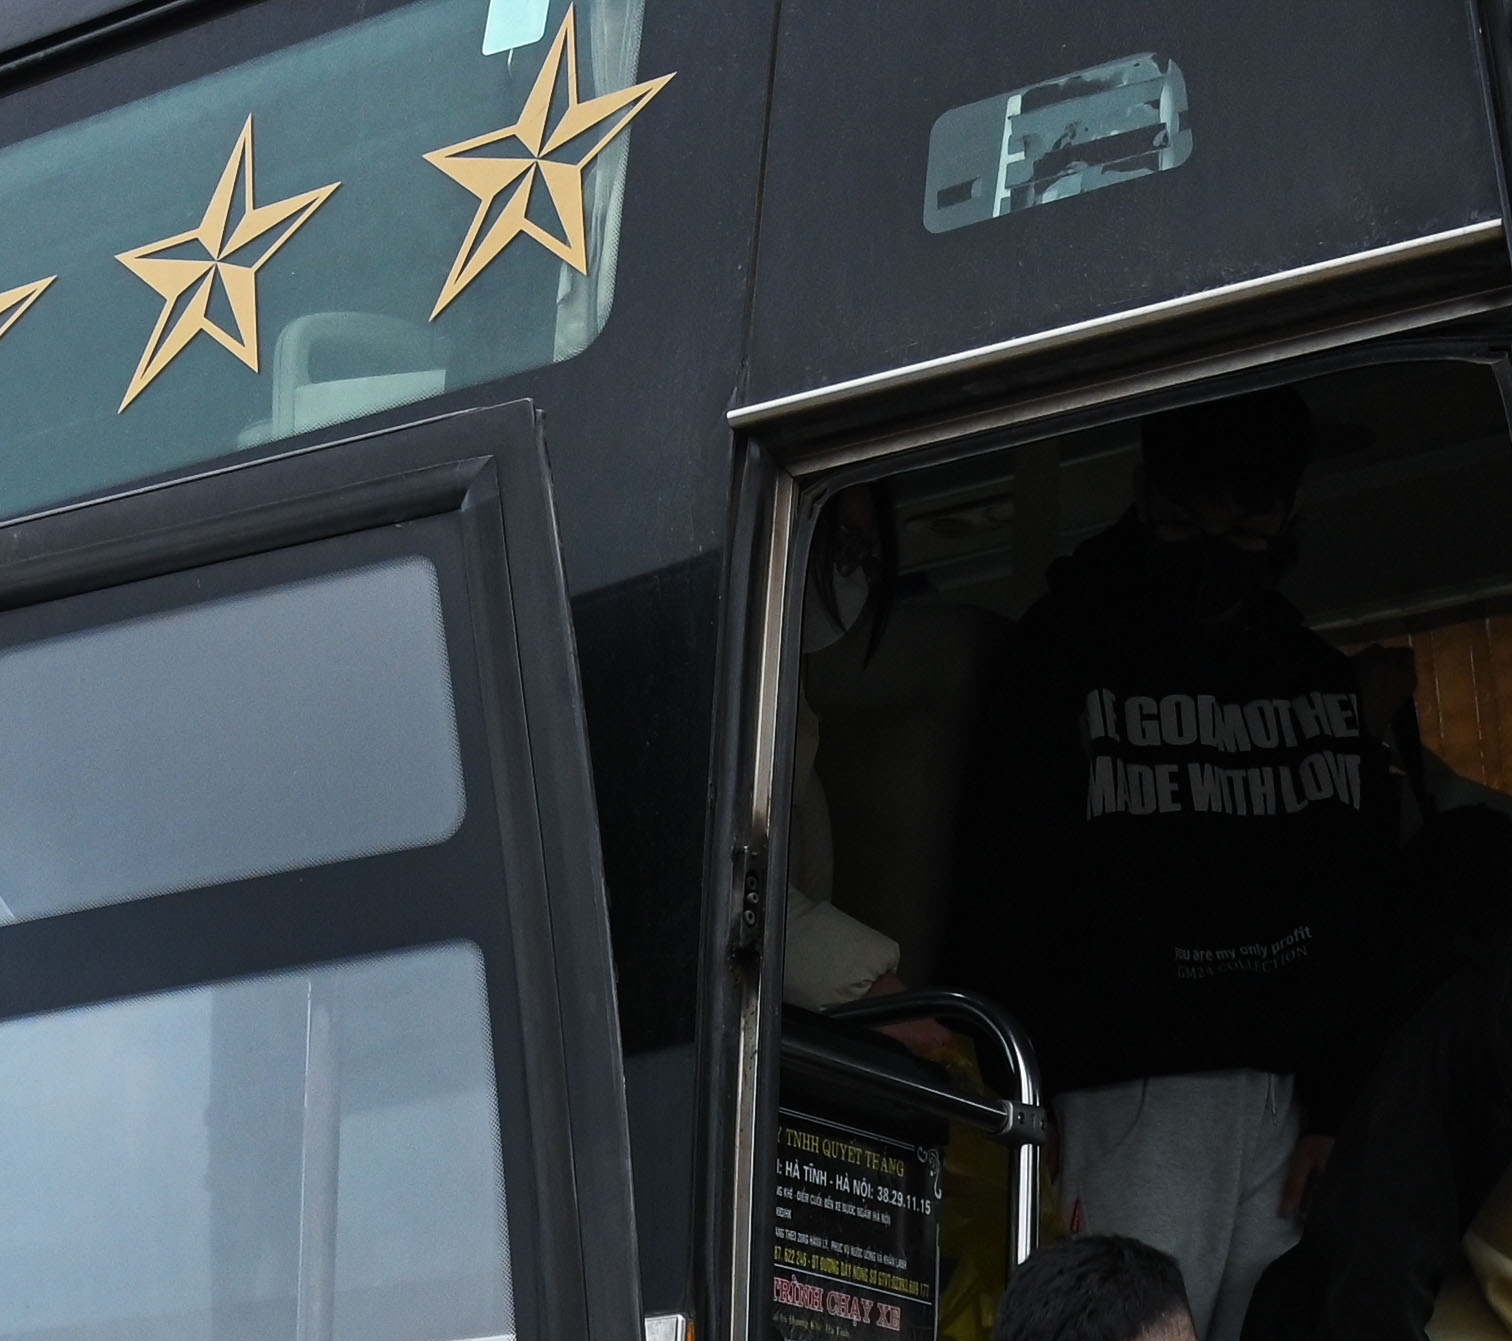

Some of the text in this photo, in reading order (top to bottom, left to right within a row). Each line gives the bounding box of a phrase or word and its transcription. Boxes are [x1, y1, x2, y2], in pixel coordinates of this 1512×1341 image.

[1086, 755, 1183, 821] MADE
[1187, 762, 1277, 816] WITH
[1271, 925, 1313, 955] profit
[785, 1128, 819, 1153] TNHH
[822, 1138, 862, 1165] QUYẾT
[785, 1159, 800, 1180] HÀ
[803, 1163, 827, 1187] TĨNH
[836, 1172, 850, 1193] HÀ
[853, 1177, 874, 1203] NỘI:
[877, 1186, 931, 1215] 38.29.11.15
[826, 1290, 874, 1327] CHẠY
[876, 1302, 901, 1330] XE
